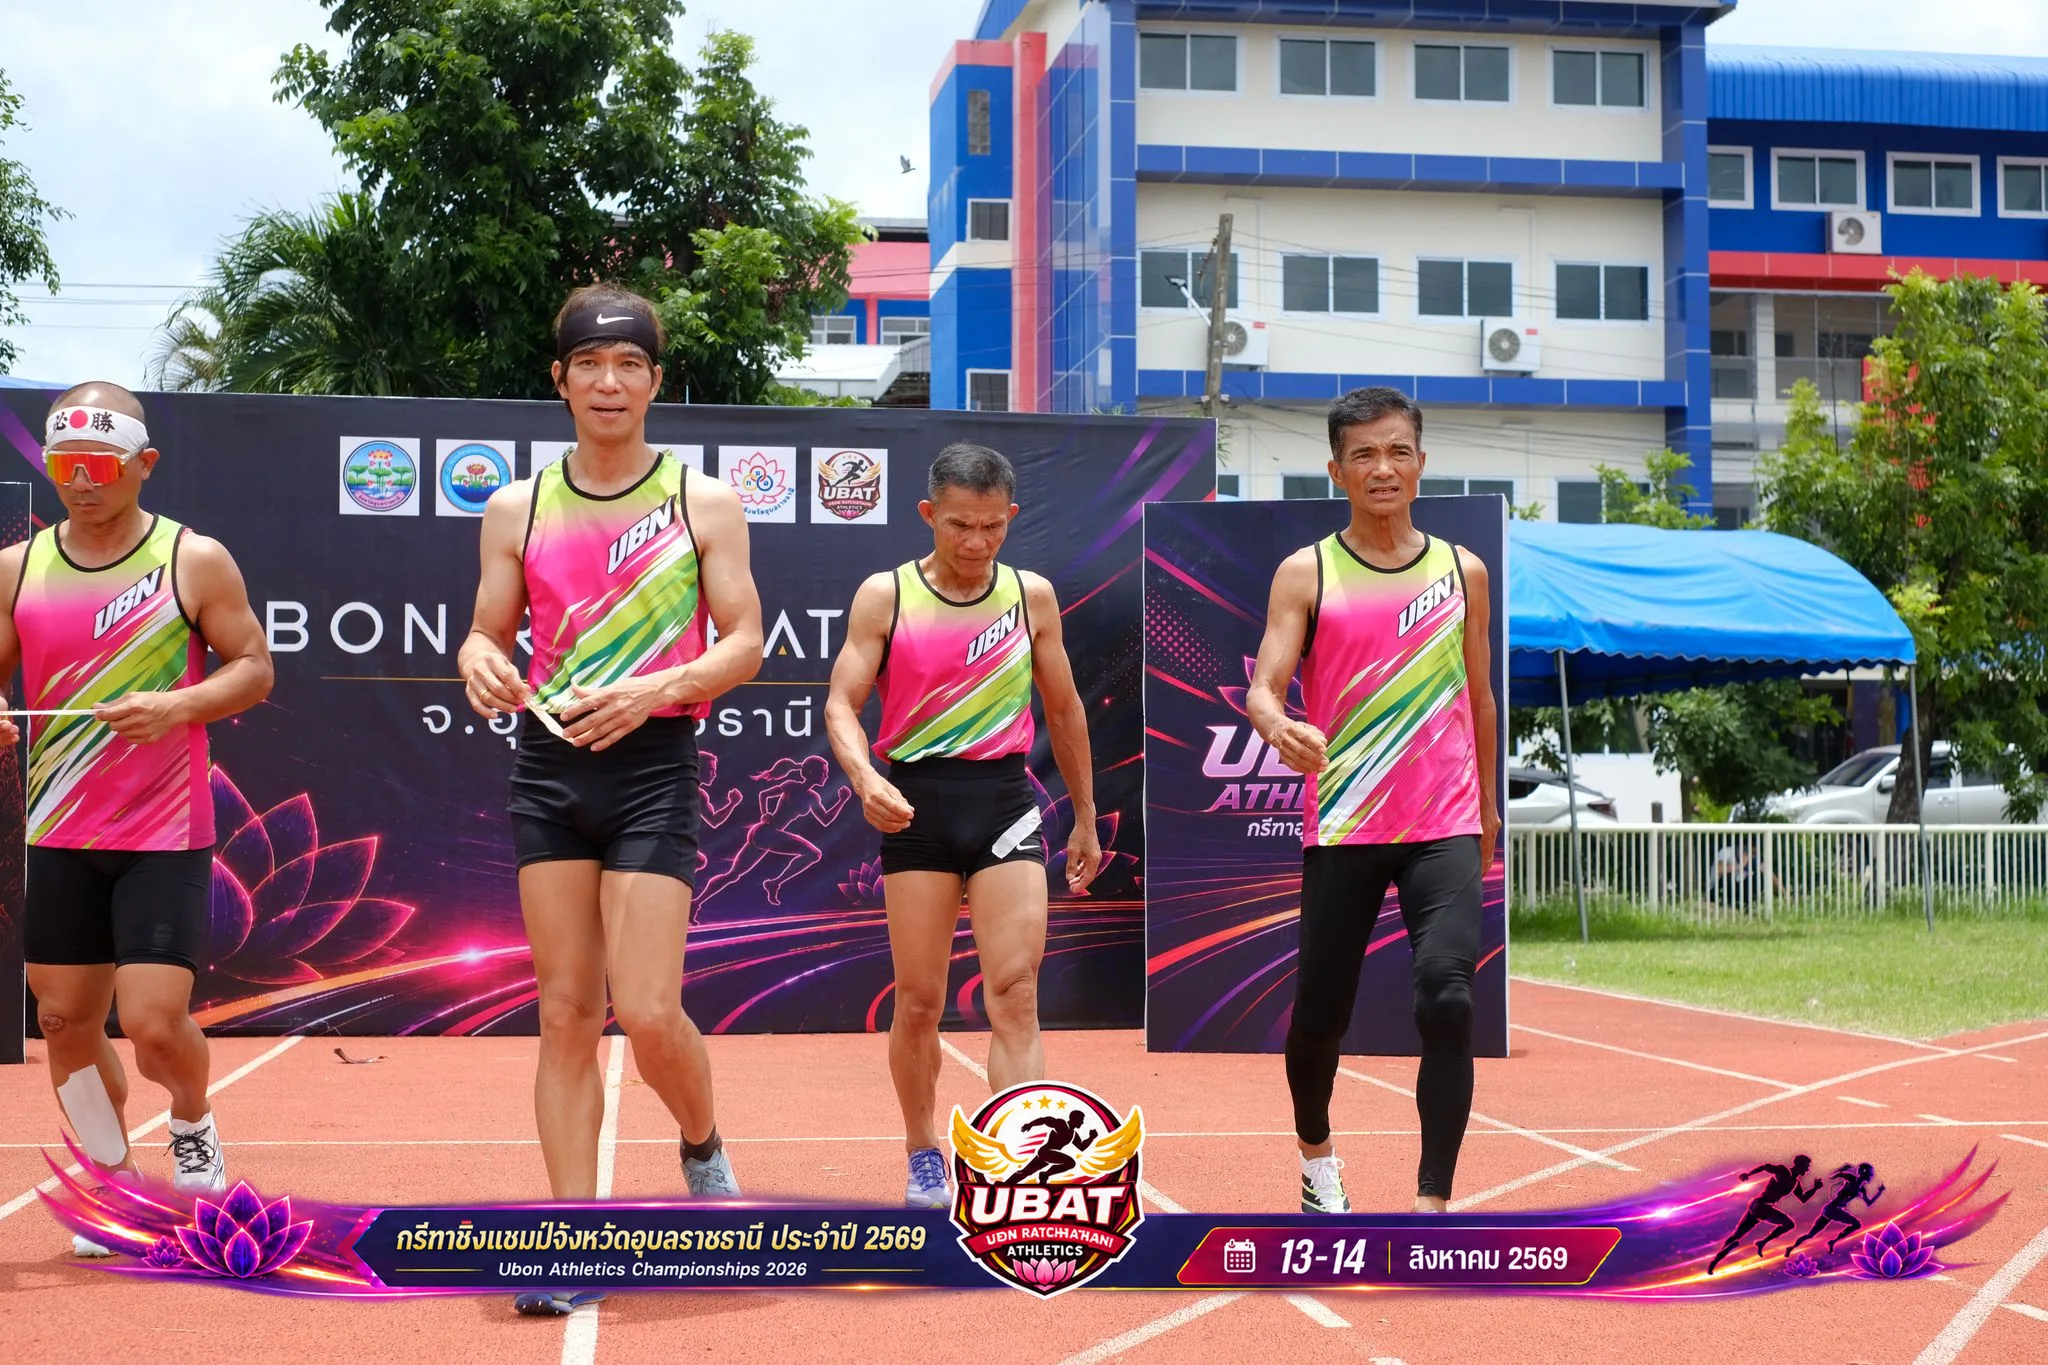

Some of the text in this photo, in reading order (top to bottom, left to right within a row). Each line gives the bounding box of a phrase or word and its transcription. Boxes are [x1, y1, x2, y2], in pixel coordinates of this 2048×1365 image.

[823, 486, 877, 500] UBAT
[606, 495, 674, 575] UBN
[93, 566, 163, 640] UBN
[207, 600, 447, 655] BON
[965, 603, 1018, 667] UBN
[1397, 572, 1452, 638] UBN
